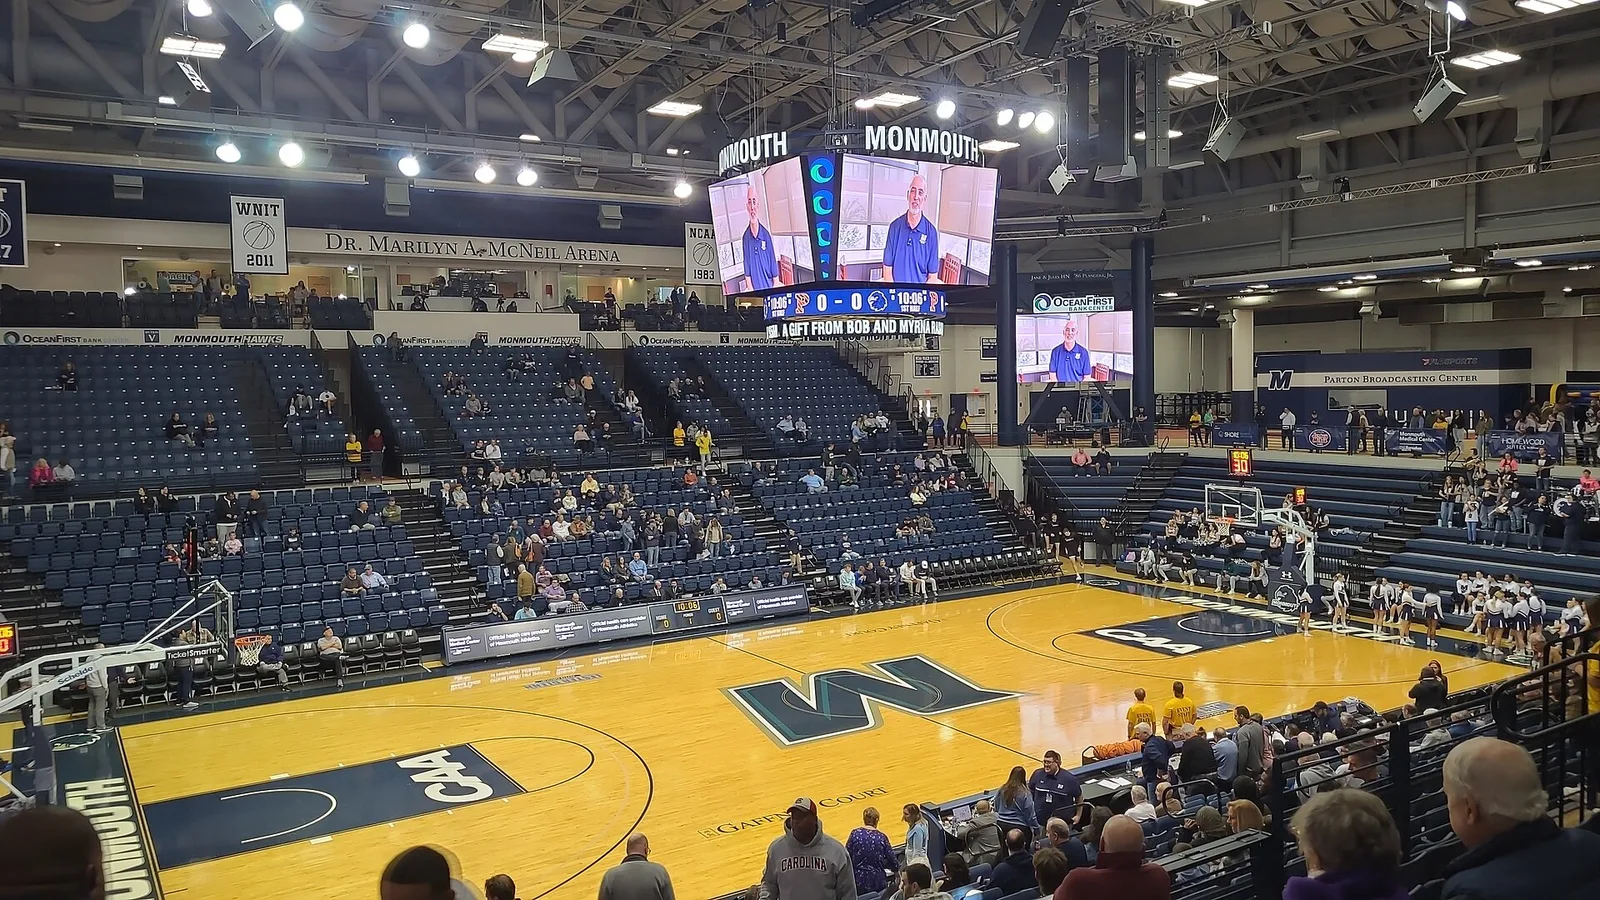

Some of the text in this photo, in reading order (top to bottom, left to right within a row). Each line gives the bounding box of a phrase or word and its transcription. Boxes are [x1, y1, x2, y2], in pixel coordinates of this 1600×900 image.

[865, 125, 979, 163] MONMOUTH
[235, 201, 280, 219] WNIT
[246, 252, 275, 268] 2011
[693, 269, 715, 280] 1983
[770, 296, 787, 310] 10:06
[817, 294, 828, 311] 0
[851, 293, 862, 311] 0
[897, 292, 923, 305] 10:06
[782, 323, 789, 337] A
[789, 321, 809, 337] GIFT
[811, 320, 843, 336] FROM
[847, 319, 870, 335] BOB
[873, 319, 896, 334] AND
[899, 319, 930, 335] MYRNA
[147, 334, 157, 342] V
[1224, 431, 1239, 439] SHORE
[1502, 437, 1545, 446] HOMEWOOD
[1234, 460, 1248, 472] 30
[676, 602, 698, 611] 10:06
[591, 619, 608, 628] Official
[608, 617, 619, 626] health
[629, 614, 647, 624] provider
[597, 623, 620, 633] Monmouth
[620, 621, 638, 630] Athletics
[664, 620, 669, 628] 0
[489, 633, 506, 641] Official
[507, 632, 520, 640] health
[531, 628, 550, 638] provider
[495, 638, 520, 647] Monmouth
[521, 635, 540, 643] Athletics
[1094, 628, 1203, 655] CAA
[167, 646, 221, 660] TicketSmarter
[57, 666, 95, 686] Schelde
[396, 749, 493, 803] CAA
[716, 786, 888, 835] GAFFN COURT
[781, 856, 828, 872] CAROLINA
